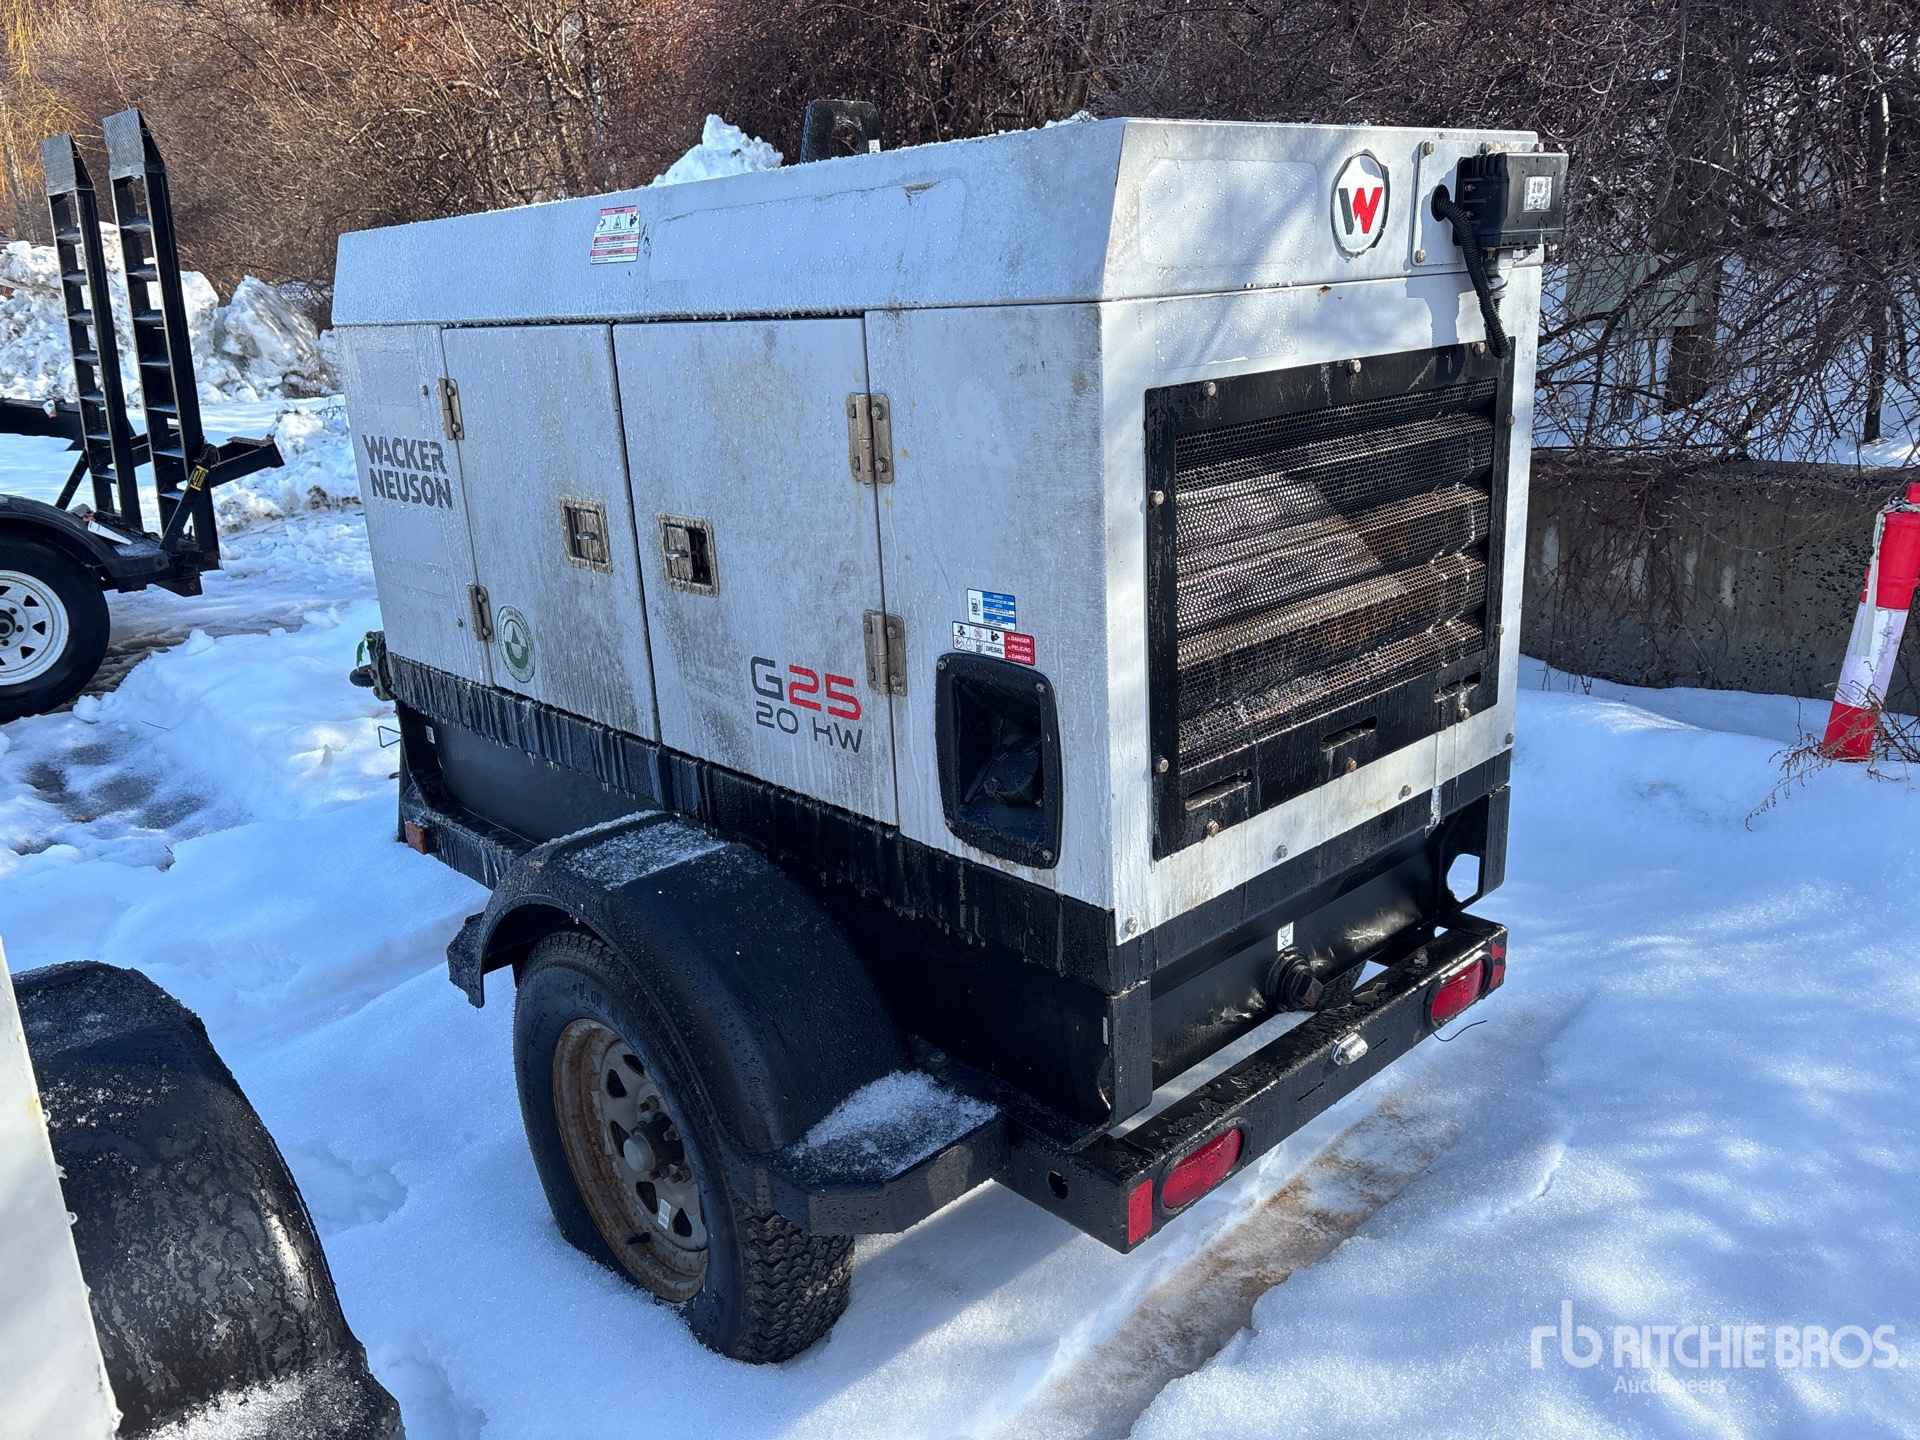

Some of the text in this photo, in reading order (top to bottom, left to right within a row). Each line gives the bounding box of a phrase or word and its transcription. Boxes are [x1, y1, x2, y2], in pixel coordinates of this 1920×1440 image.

[362, 435, 447, 474] WACKER
[369, 468, 453, 510] NEUSON
[985, 645, 1004, 655] DIESEL
[1010, 635, 1030, 644] DANGER
[1011, 644, 1031, 653] PELIGRO
[1011, 653, 1031, 662] DANGER
[750, 656, 862, 720] G25
[756, 700, 799, 734] 20
